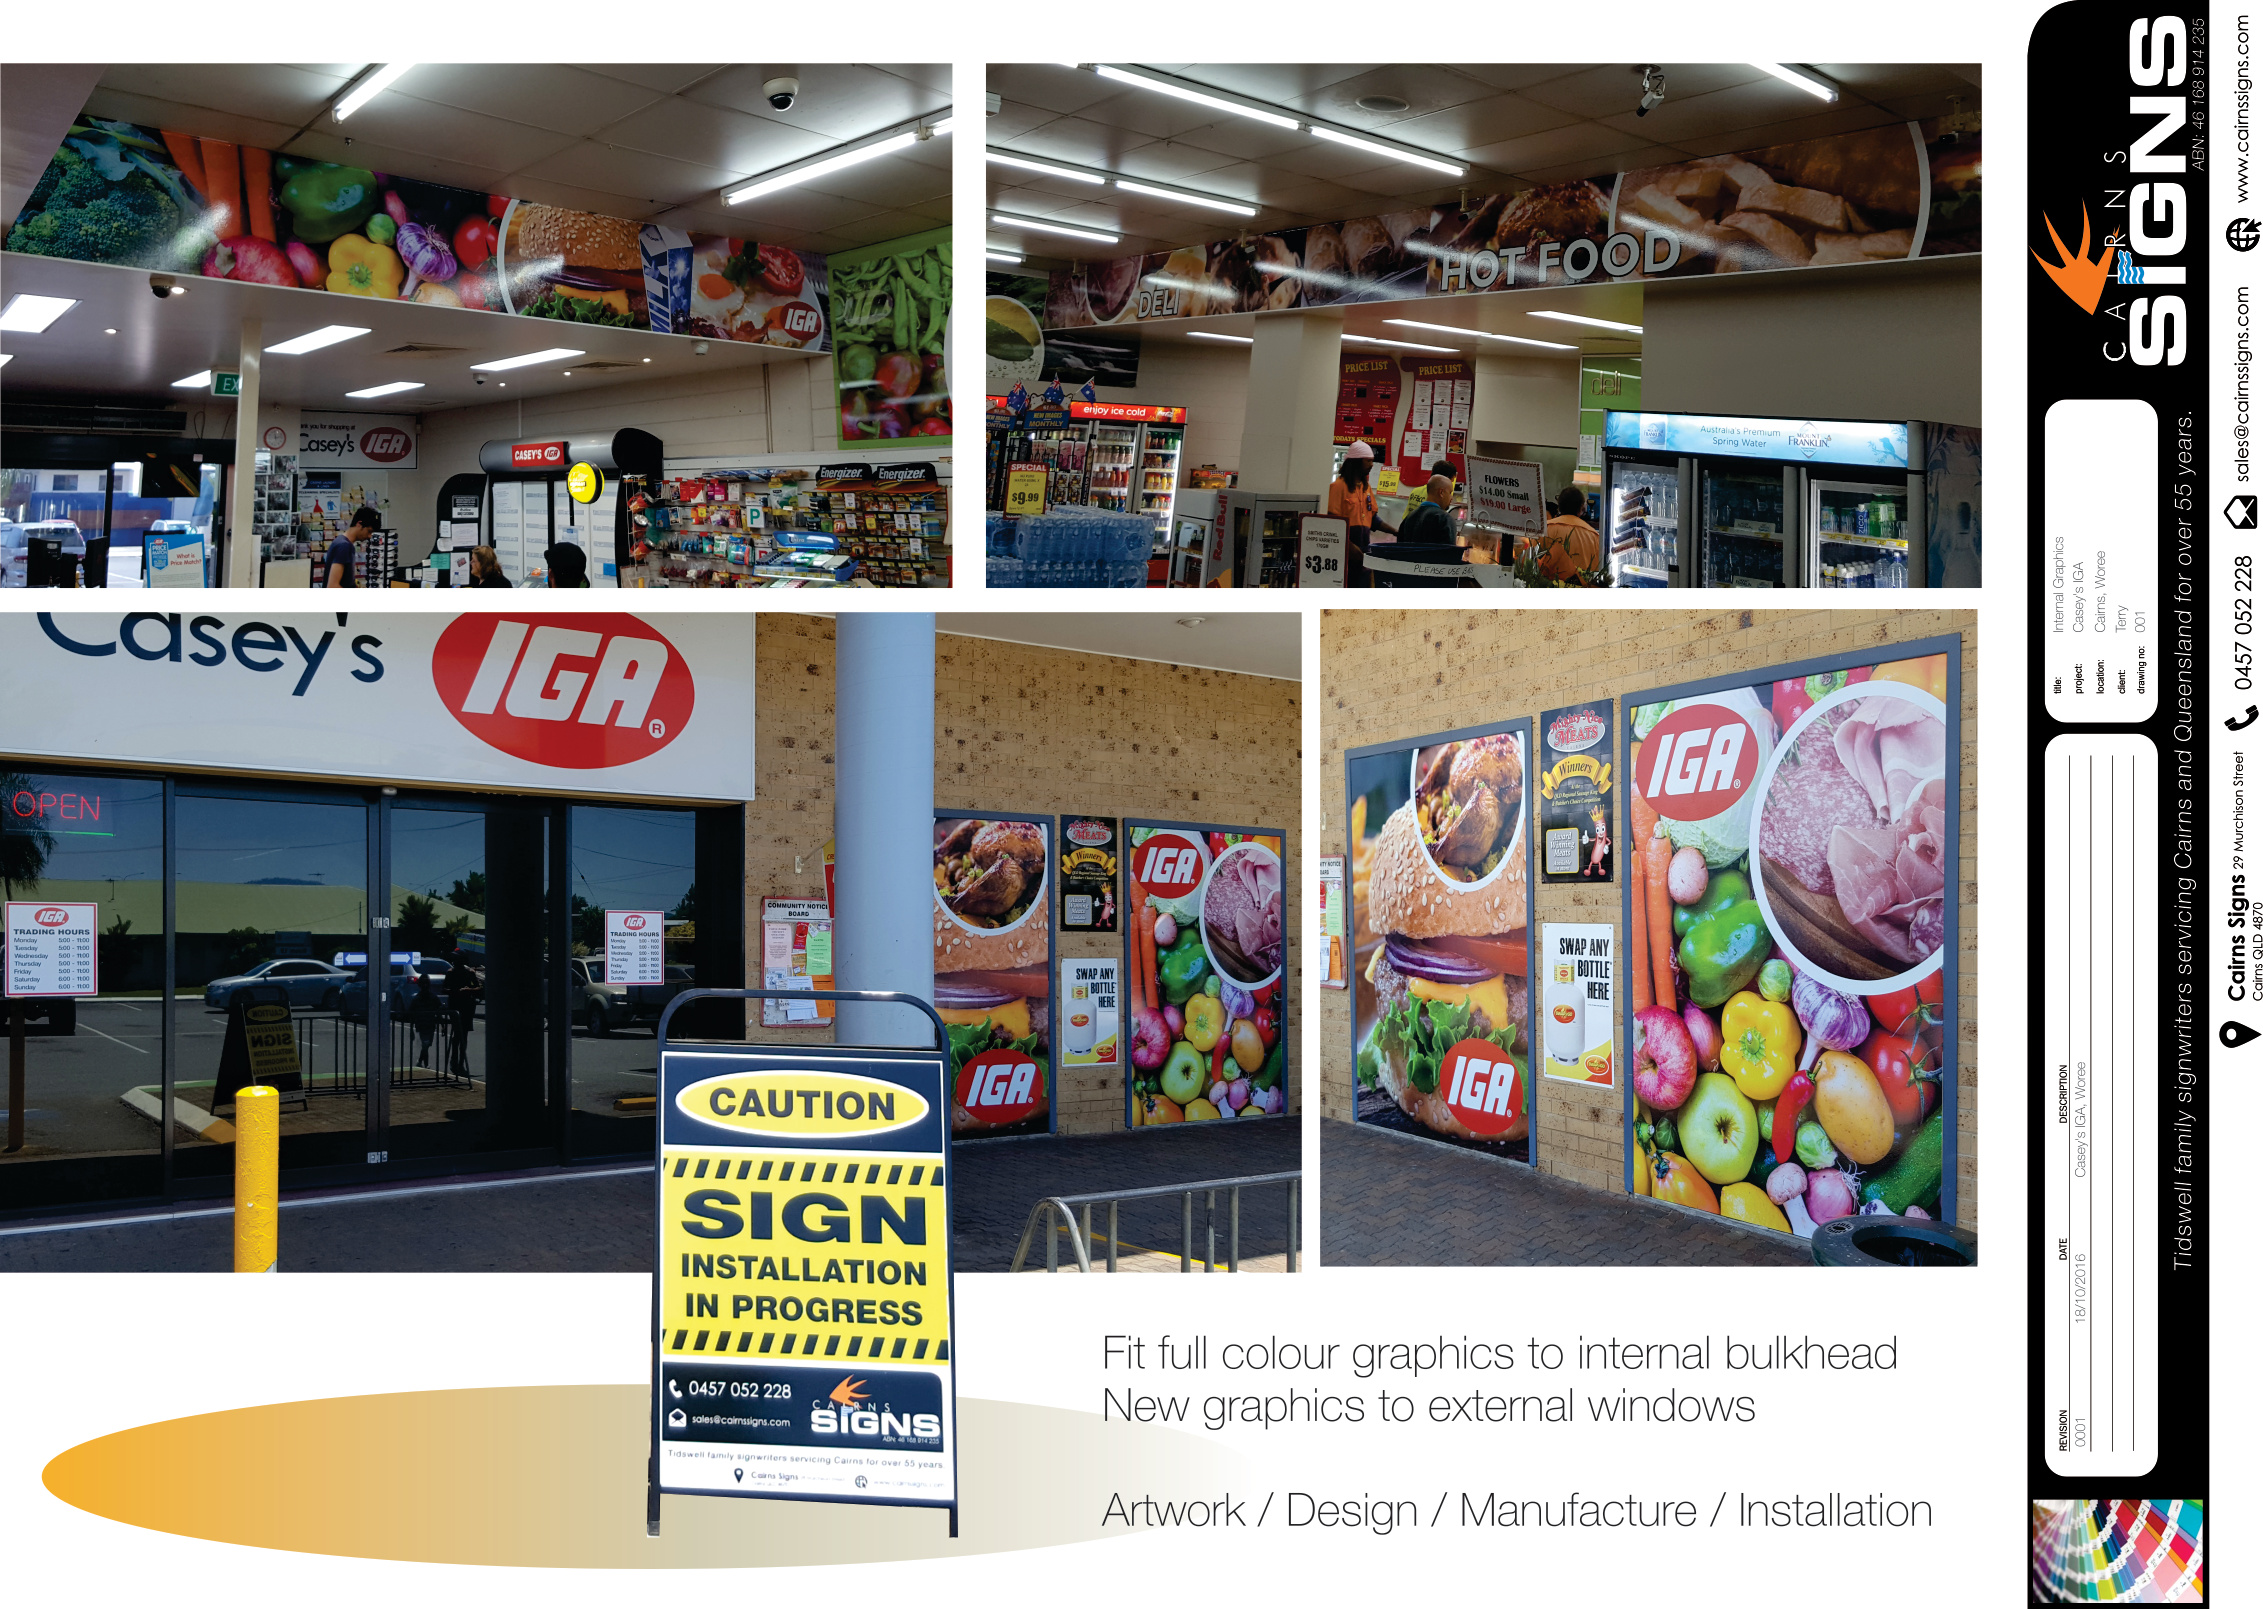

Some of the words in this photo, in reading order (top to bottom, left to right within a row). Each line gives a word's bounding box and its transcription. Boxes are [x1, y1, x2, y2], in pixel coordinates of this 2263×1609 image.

[1441, 246, 1526, 291] HOT
[1537, 229, 1681, 283] FOOD
[639, 239, 671, 333] MILK
[1137, 288, 1180, 318] DELI
[784, 309, 818, 332] IGA
[1345, 362, 1370, 373] PRICE
[1371, 361, 1389, 371] LIST
[1419, 366, 1444, 376] PRICE
[1445, 364, 1463, 374] LIST
[1591, 370, 1622, 396] deli
[1083, 405, 1109, 415] enjoy
[1111, 406, 1124, 415] ice
[1126, 407, 1146, 416] cold
[1700, 425, 1740, 435] Australia's
[1743, 427, 1781, 437] Premium
[300, 433, 354, 457] Casey's
[365, 434, 405, 453] IGA
[1712, 437, 1739, 447] Spring
[1742, 438, 1766, 448] Water
[1788, 435, 1829, 447] FRANKLIN
[514, 449, 542, 460] CASEY'S
[820, 466, 862, 480] Energizer
[879, 466, 925, 482] Energizer
[1484, 474, 1520, 488] FLOWERS
[1379, 480, 1396, 488] $15.99
[1012, 492, 1039, 505] $9.99
[1479, 485, 1505, 498] $14.00
[1506, 488, 1529, 501] Small
[1217, 494, 1228, 526] Bull
[1480, 497, 1506, 511] $19.00
[1507, 502, 1531, 515] Large
[750, 509, 761, 525] P
[1213, 527, 1225, 561] Red
[1305, 555, 1338, 574] $3.88
[1414, 564, 1445, 574] PLEASE
[37, 612, 385, 696] Casey's
[462, 620, 668, 728] IGA
[1554, 726, 1598, 747] MEATS
[1646, 721, 1747, 798] IGA
[1559, 761, 1592, 776] Winners
[12, 790, 100, 820] OPEN
[1073, 829, 1107, 840] MEATS
[1553, 832, 1572, 840] Award
[1550, 841, 1575, 849] Winning
[1553, 849, 1571, 857] Meats
[1076, 850, 1102, 862] Winners
[1140, 846, 1200, 884] IGA
[38, 911, 65, 923] IGA
[626, 917, 644, 926] IGA
[1560, 937, 1586, 956] SWAP
[1589, 939, 1609, 956] ANY
[1076, 968, 1097, 980] SWAP
[1100, 968, 1114, 980] ANY
[1587, 982, 1609, 1000] HERE
[1098, 996, 1115, 1008] HERE
[966, 1063, 1037, 1106] IGA
[1448, 1058, 1515, 1115] IGA
[709, 1088, 895, 1120] CAUTION
[681, 1189, 927, 1245] SIGN
[682, 1254, 927, 1286] INSTALLATION
[686, 1294, 718, 1318] IN
[733, 1296, 923, 1326] PROGRESS
[689, 1380, 726, 1396] 0457
[730, 1382, 759, 1398] 052
[763, 1383, 791, 1399] 228
[812, 1399, 890, 1413] CAIRNS
[692, 1415, 790, 1427] sales@cairnssigns.com
[811, 1408, 940, 1438] SIGNS
[668, 1450, 704, 1458] Tidswell
[707, 1451, 734, 1461] family
[737, 1453, 787, 1461] signwriters
[790, 1455, 831, 1465] servicing
[834, 1456, 863, 1465] Cairns
[751, 1471, 776, 1479] Cairns
[778, 1472, 798, 1481] Signs
